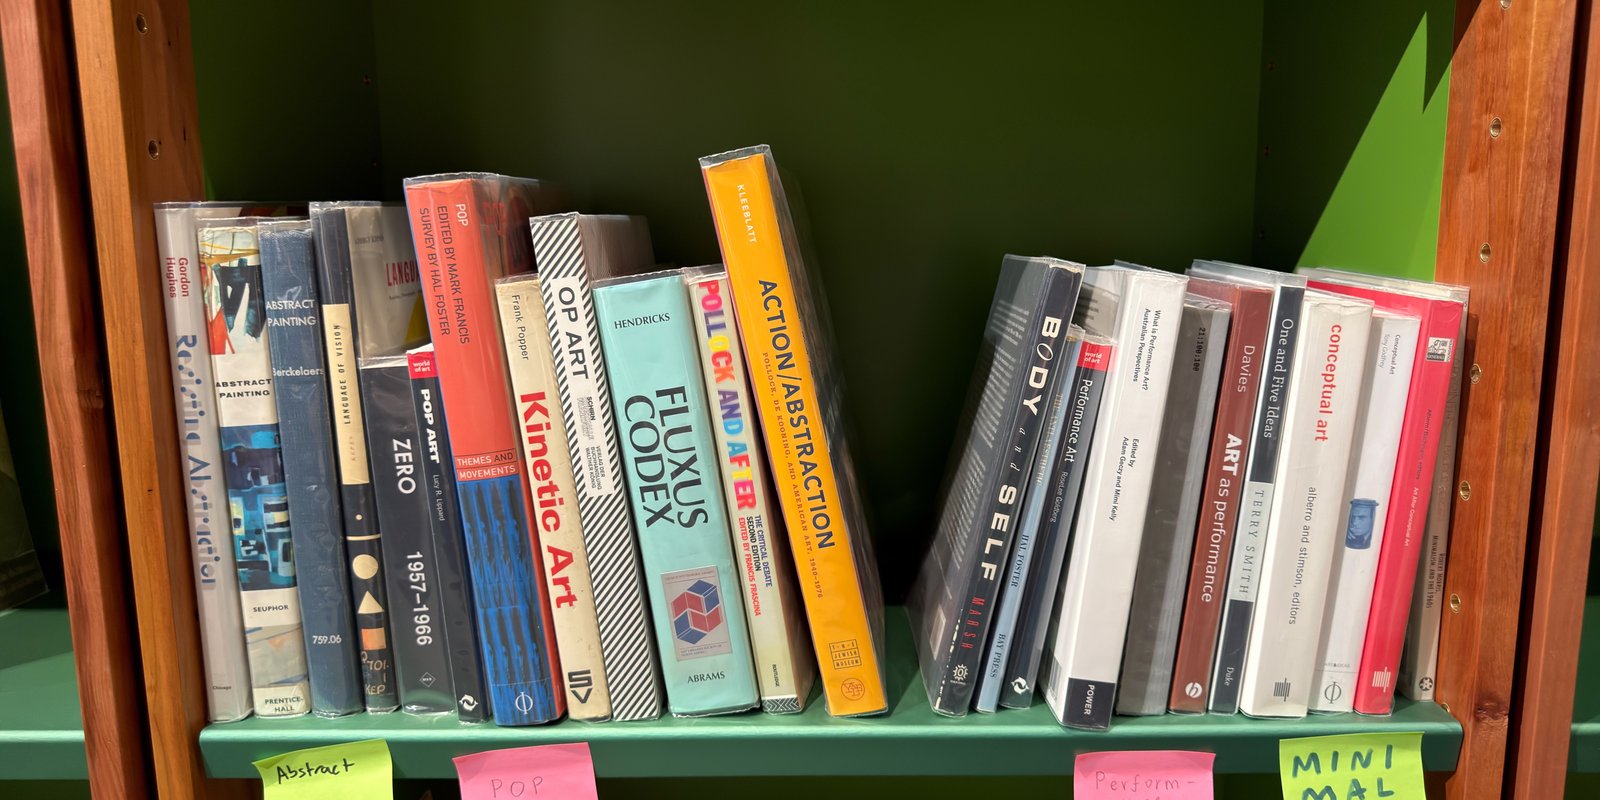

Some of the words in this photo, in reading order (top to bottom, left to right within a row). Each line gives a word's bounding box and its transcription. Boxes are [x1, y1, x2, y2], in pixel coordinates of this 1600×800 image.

[420, 207, 437, 251] SURVEY
[437, 205, 453, 245] EDITED
[456, 204, 469, 226] POP
[737, 184, 757, 243] KLEEBLATT
[427, 254, 438, 267] BY
[444, 247, 456, 261] BY
[166, 257, 177, 298] Hughes
[179, 257, 191, 297] Gordon
[431, 269, 442, 292] HAL
[448, 263, 461, 295] MARK
[266, 300, 315, 310] ABSTRACT
[436, 294, 450, 335] FOSTER
[453, 297, 470, 344] FRANCIS
[512, 294, 523, 322] Frank
[558, 286, 578, 323] OP
[614, 312, 670, 329] HENDRICKS
[1152, 310, 1161, 327] What
[268, 316, 316, 327] PAINTING
[699, 280, 735, 384] POLLOCK
[1139, 308, 1151, 341] Australian
[1279, 318, 1293, 346] One
[333, 325, 343, 357] VISION
[517, 326, 529, 360] Popper
[566, 331, 589, 380] ART
[1144, 335, 1157, 376] Performance
[1391, 334, 1400, 366] Conceptual
[338, 364, 346, 373] OF
[1023, 315, 1062, 415] BODY
[1133, 342, 1146, 382] Perspectives
[1238, 345, 1255, 393] Davies
[1274, 348, 1287, 373] and
[1319, 324, 1342, 414] conceptual
[216, 379, 272, 388] ABSTRACT
[220, 390, 270, 398] PAINTING
[1142, 376, 1150, 391] Art?
[1270, 376, 1284, 403] Five
[339, 380, 351, 424] LANGUAGE
[421, 389, 434, 425] POP
[587, 396, 596, 421] SCHIRN
[717, 388, 744, 435] AND
[758, 279, 836, 549] ACTION/ABSTRACTION
[1068, 379, 1093, 444] Performance
[1264, 406, 1280, 438] Ideas
[1315, 419, 1329, 442] art
[426, 428, 440, 464] ART
[656, 386, 708, 528] FLUXUS
[763, 352, 776, 396] POLLOCK,
[774, 399, 782, 412] DE
[787, 462, 796, 480] AND
[793, 484, 808, 532] AMERICAN
[1010, 427, 1026, 472] and
[1064, 445, 1077, 462] Art
[1121, 436, 1129, 455] Adam
[1130, 438, 1139, 459] Edited
[1222, 433, 1242, 476] ART
[393, 439, 416, 494] ZERO
[457, 456, 492, 467] THEMES
[493, 453, 514, 462] AND
[459, 465, 516, 479] MOVEMENTS
[624, 395, 675, 528] CODEX
[727, 441, 757, 510] AFTER
[1128, 459, 1136, 468] by
[520, 391, 565, 532] Kinetic
[547, 545, 578, 609] Art
[1218, 478, 1231, 497] as
[1305, 486, 1316, 521] alberro
[739, 517, 748, 541] EDITED
[754, 514, 763, 528] THE
[1109, 505, 1118, 521] Kelly
[1248, 490, 1264, 538] TERRY
[743, 542, 750, 552] BY
[746, 516, 756, 543] SECOND
[751, 545, 761, 571] EDITION
[757, 530, 768, 560] CRITICAL
[981, 484, 1017, 581] SELF
[1017, 535, 1029, 553] HAL
[1301, 525, 1311, 544] and
[745, 553, 755, 582] FRANCIS
[1202, 501, 1227, 602] performance
[1294, 547, 1308, 588] stimson,
[762, 561, 772, 587] DEBATE
[1011, 555, 1025, 587] FOSTER
[1240, 545, 1255, 593] SMITH
[253, 604, 289, 613] SEUPHOR
[750, 584, 761, 616] FRASCINA
[1289, 592, 1300, 625] editors
[961, 596, 985, 649] MARSH
[312, 635, 342, 644] 759.06
[997, 634, 1006, 650] BAY
[687, 671, 725, 683] ABRAMS
[990, 651, 1003, 678] PRESS
[1224, 667, 1234, 686] Duke
[264, 697, 304, 705] PRENTICE-
[274, 705, 295, 713] HALL
[1084, 684, 1095, 715] POWER
[276, 758, 355, 784] Abstract
[1292, 744, 1393, 778] MINI
[491, 776, 543, 798] POP
